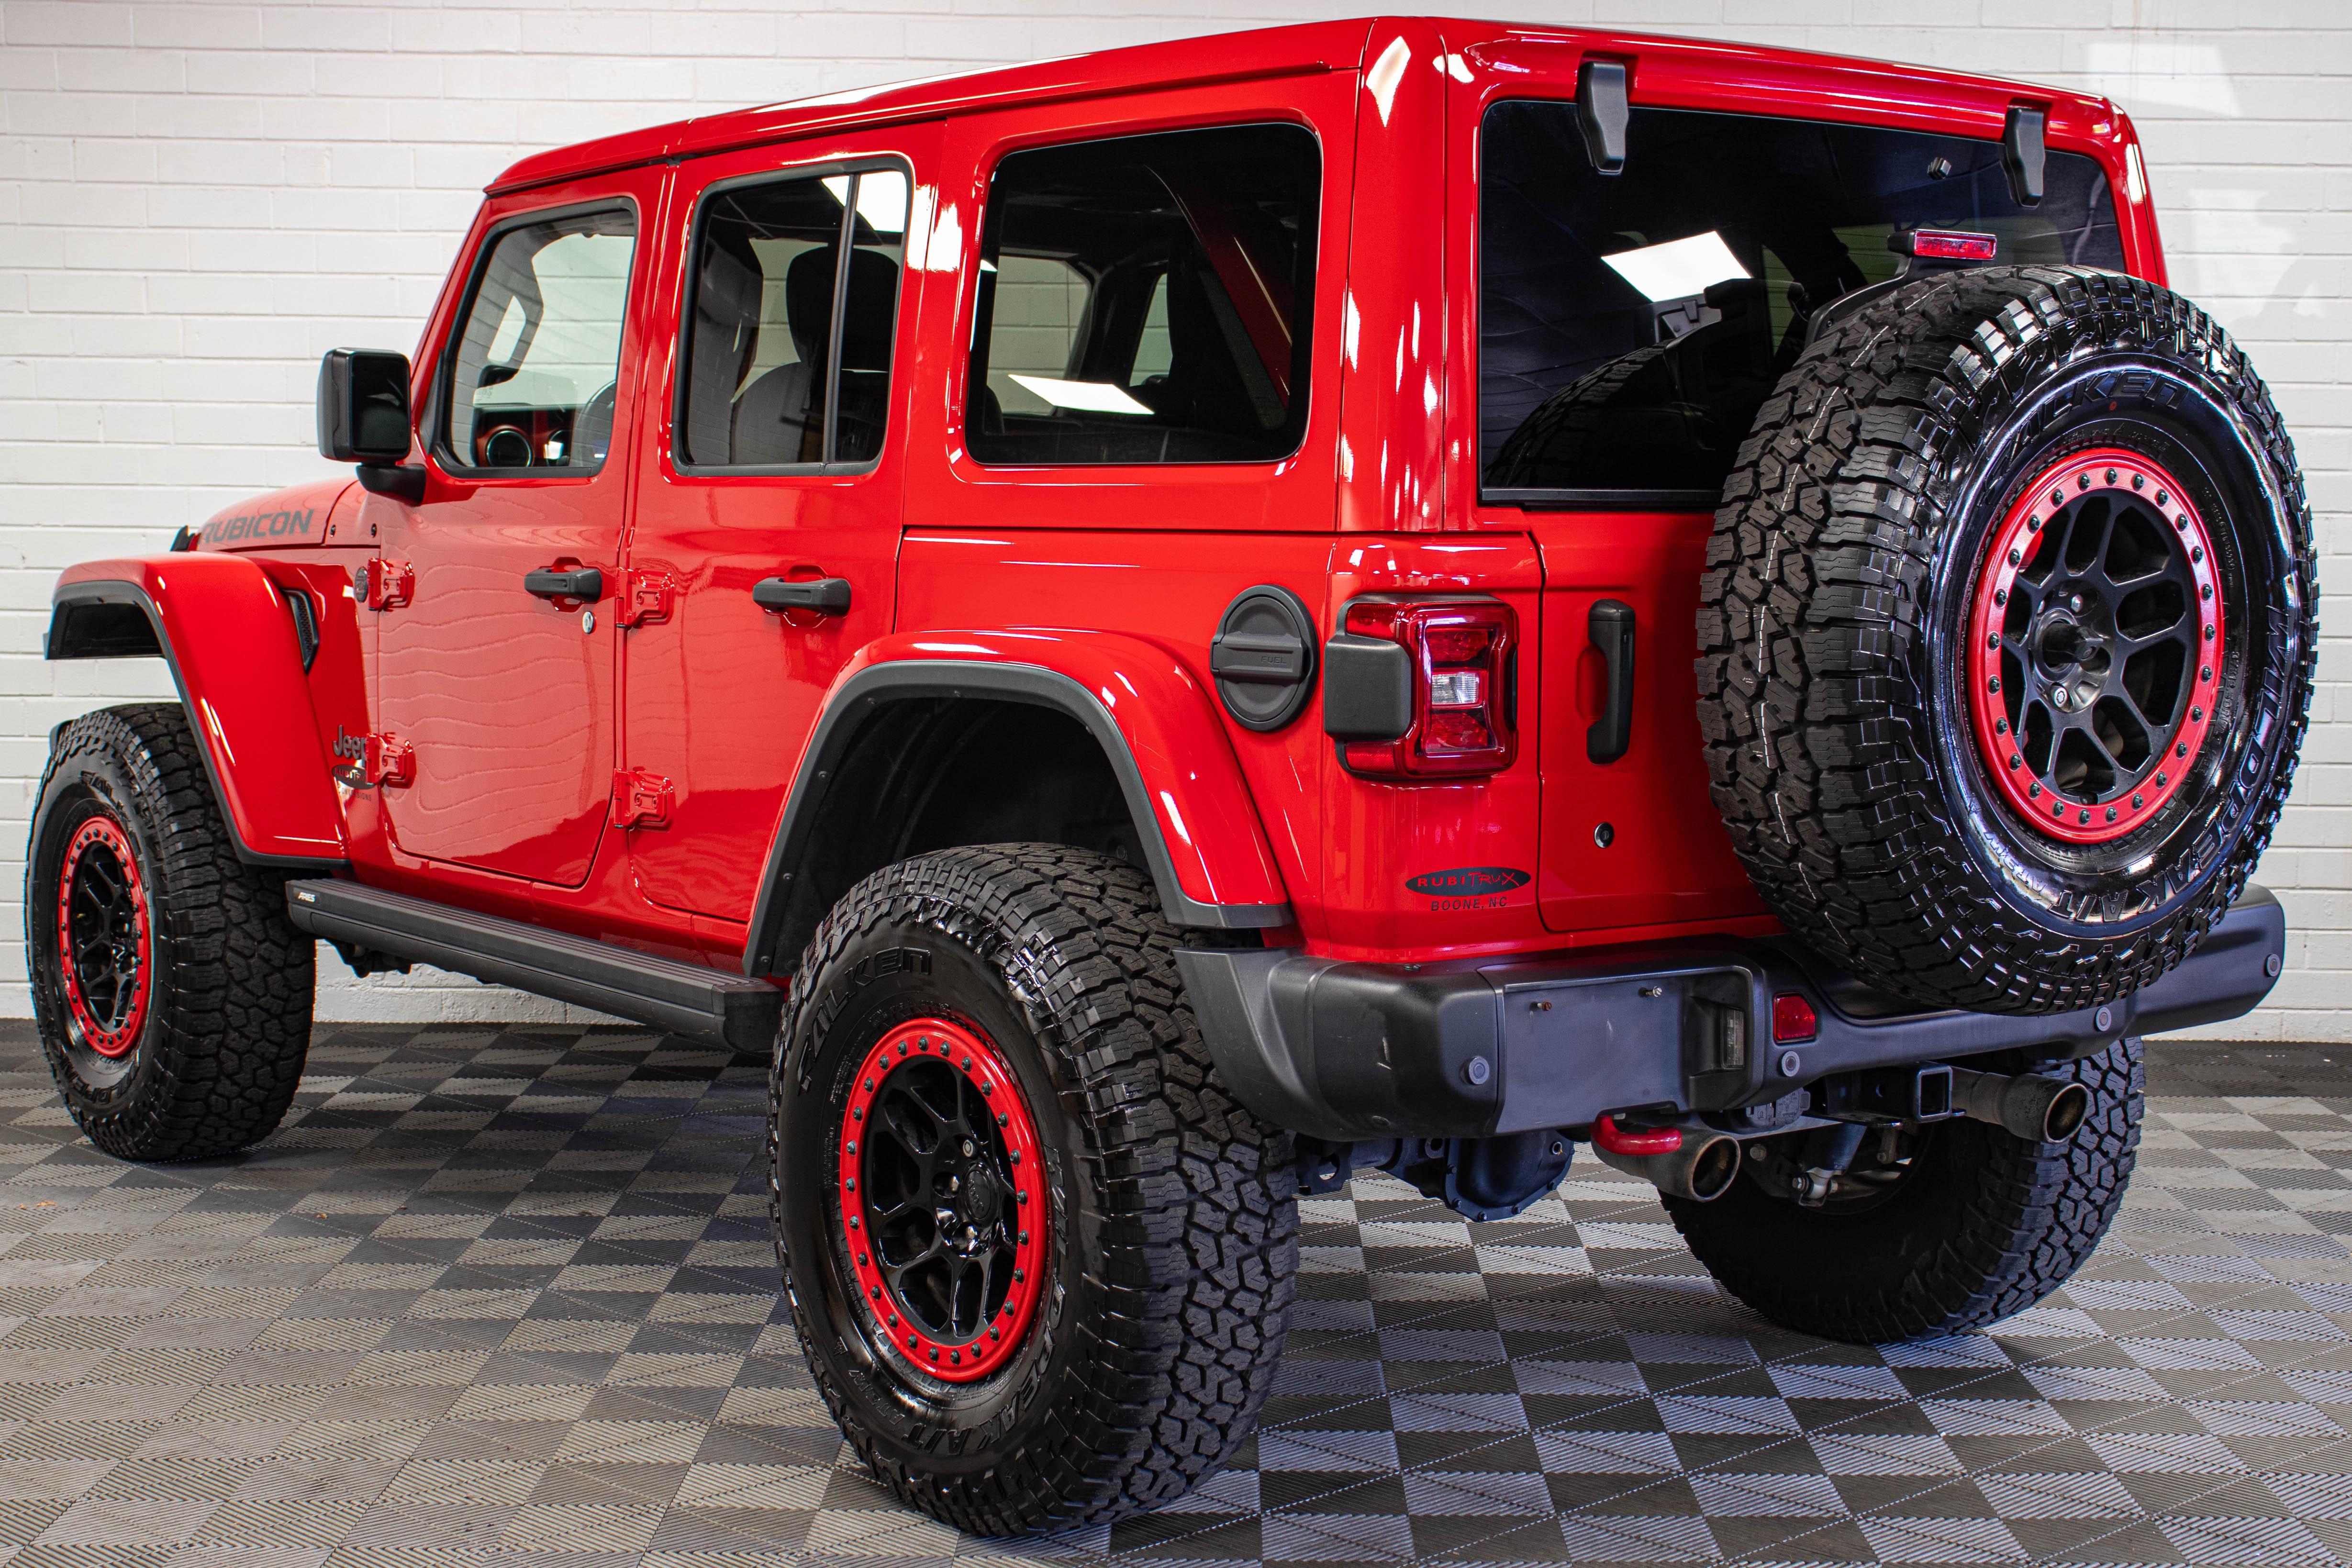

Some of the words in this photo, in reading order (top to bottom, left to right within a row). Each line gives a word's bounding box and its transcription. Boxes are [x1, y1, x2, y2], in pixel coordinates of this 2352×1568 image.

[1976, 369, 2189, 507] FALKEN
[198, 509, 315, 544] RUBICON
[1260, 655, 1286, 665] FUEL
[2136, 605, 2288, 914] WILDPEAK
[1431, 898, 1484, 912] BOONE,
[1488, 896, 1507, 908] NC
[797, 946, 932, 1097] FALKEN
[977, 1142, 1069, 1451] WILDPEAK
